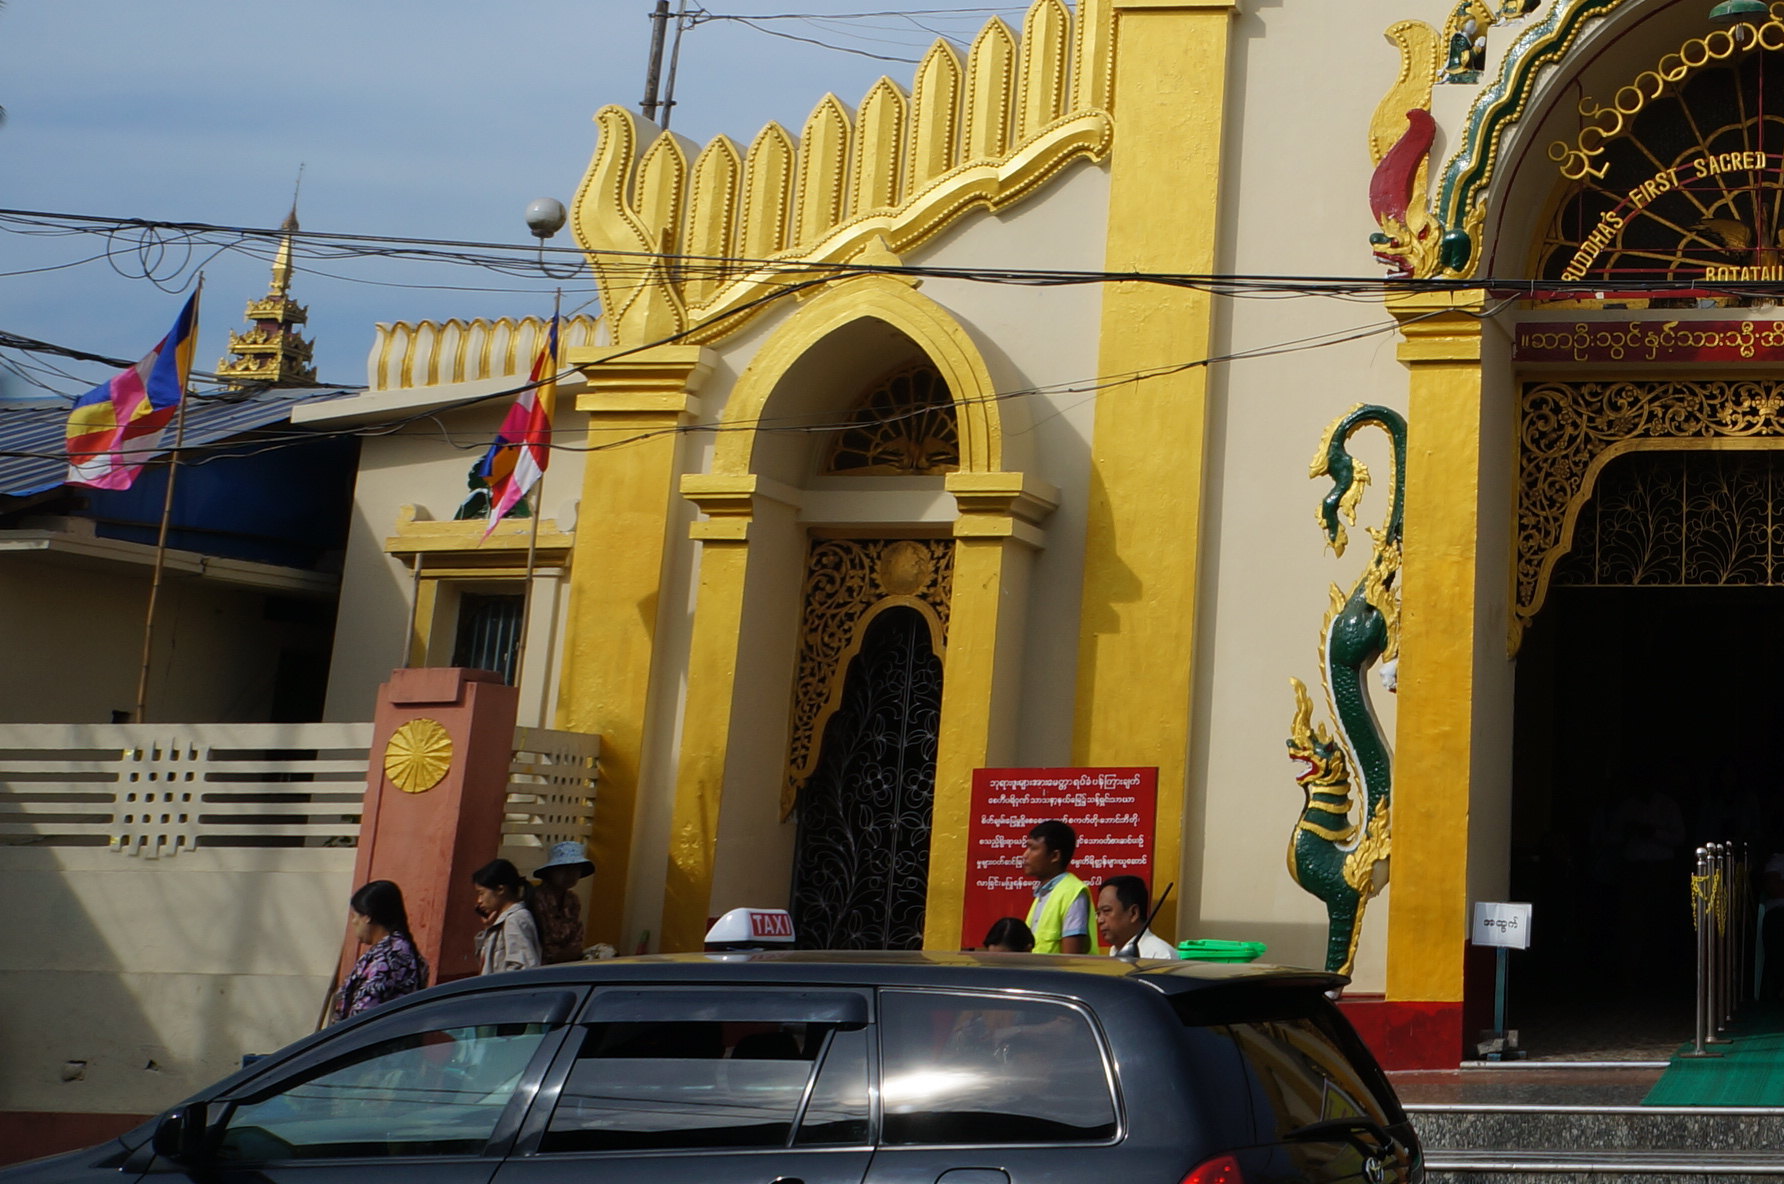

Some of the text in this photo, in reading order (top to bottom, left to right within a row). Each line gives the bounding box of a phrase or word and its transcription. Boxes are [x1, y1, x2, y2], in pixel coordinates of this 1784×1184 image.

[1561, 211, 1624, 281] BUDDHA'S
[1628, 167, 1680, 210] FIRST
[1693, 151, 1767, 179] SACRED
[753, 914, 791, 935] TAXI
